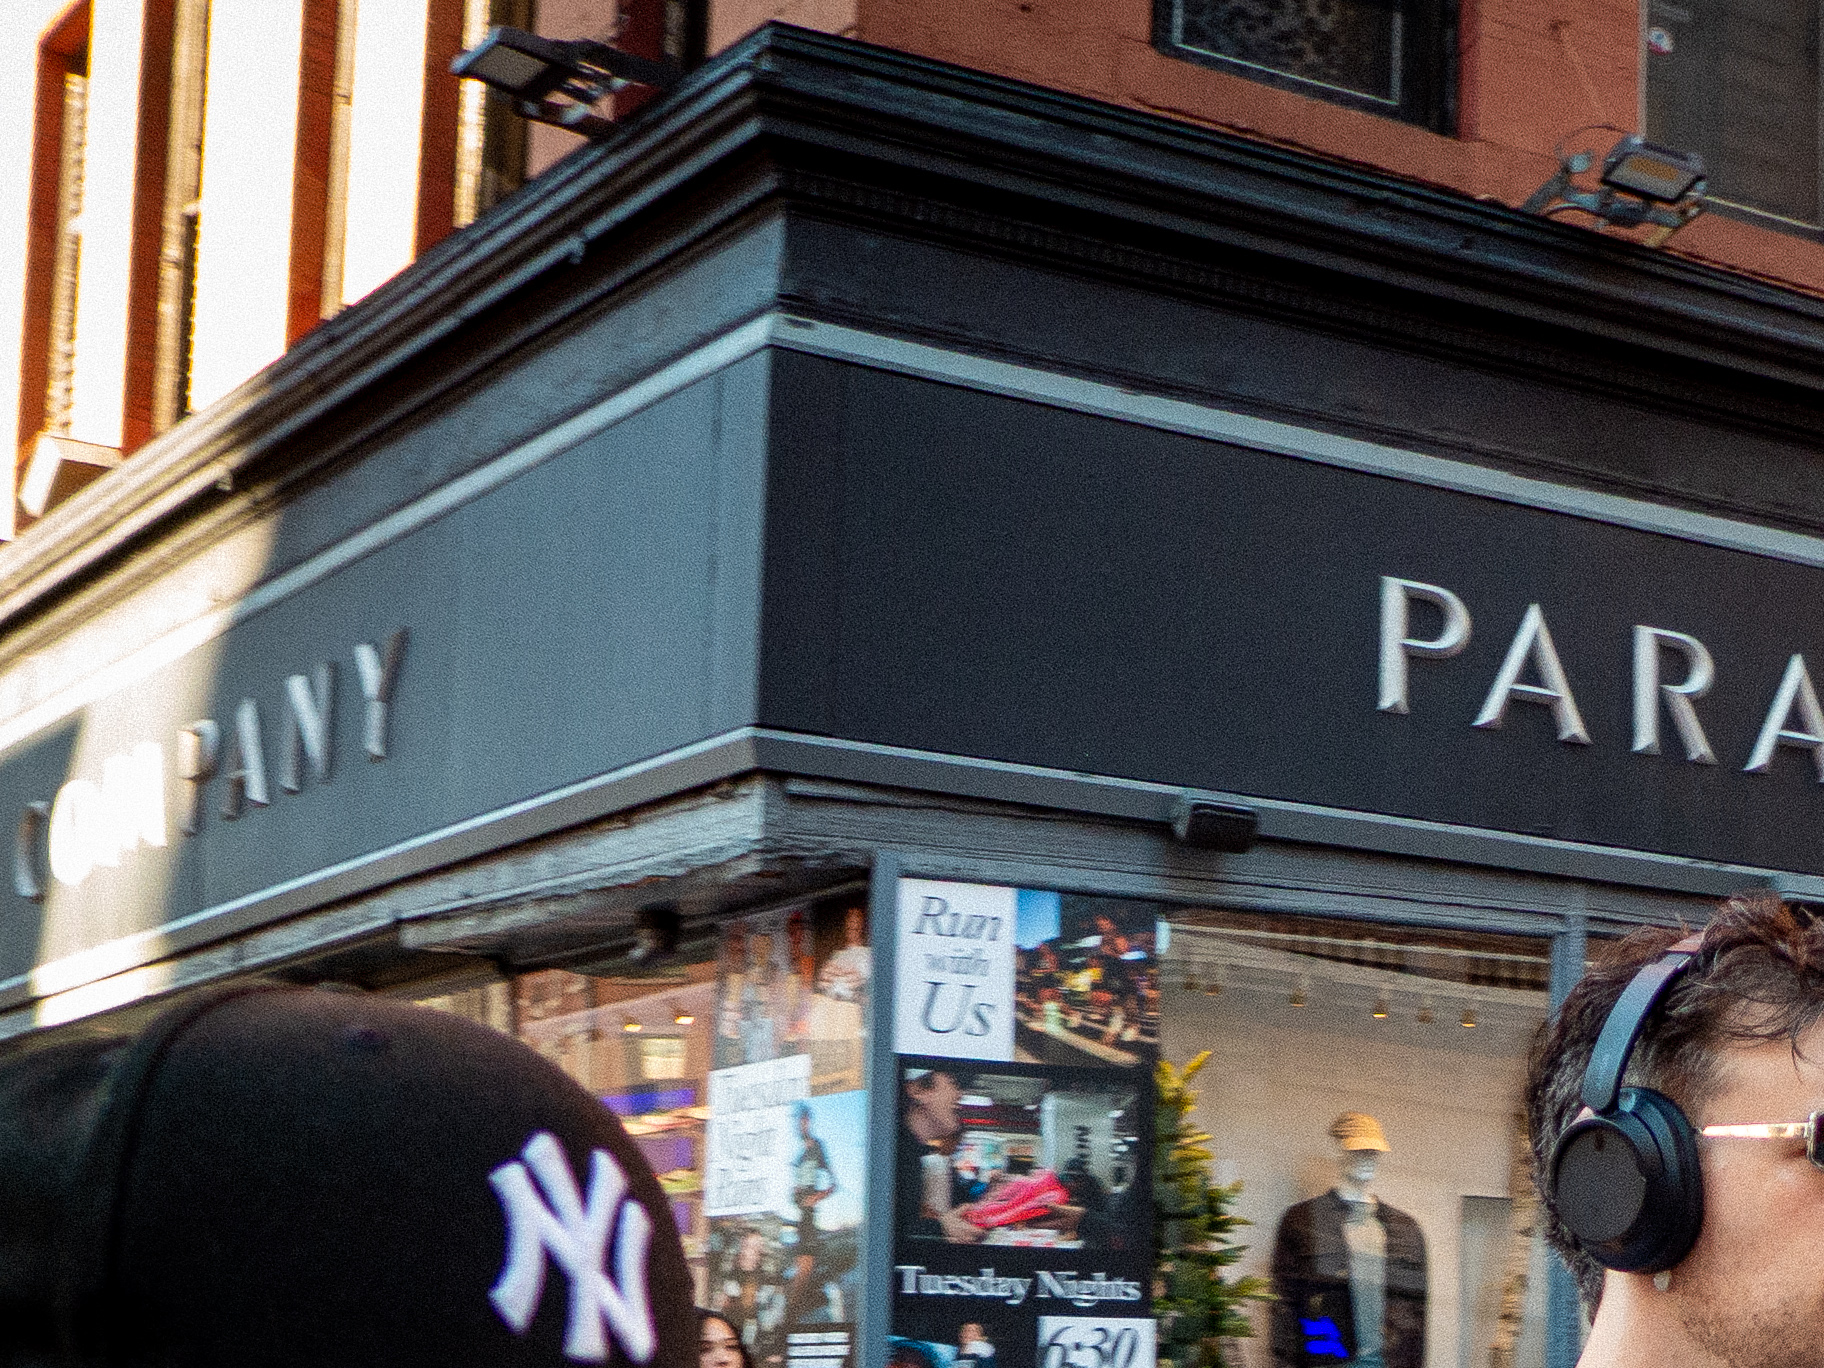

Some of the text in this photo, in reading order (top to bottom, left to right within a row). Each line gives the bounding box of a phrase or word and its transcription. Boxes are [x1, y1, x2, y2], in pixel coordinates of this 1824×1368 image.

[909, 895, 1002, 942] Run
[921, 980, 997, 1037] Us
[488, 1128, 658, 1364] NY
[894, 1265, 1142, 1307] Tuesday Nights
